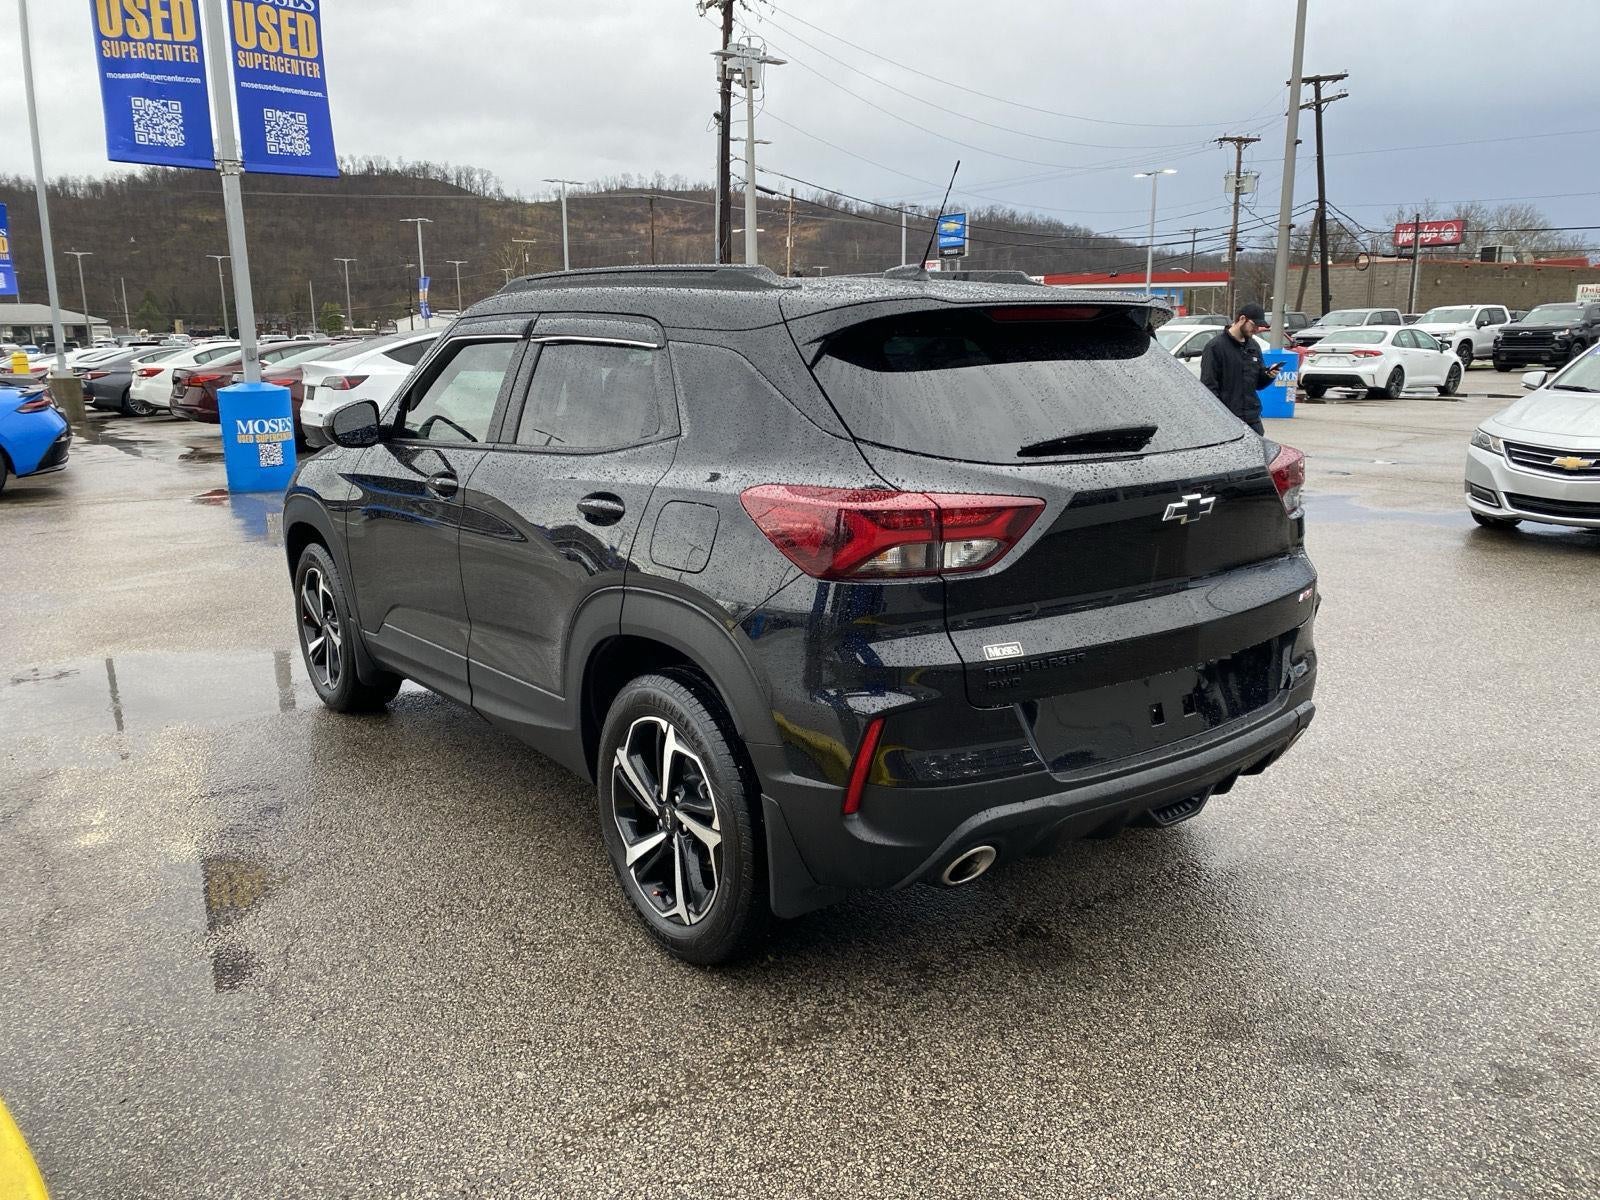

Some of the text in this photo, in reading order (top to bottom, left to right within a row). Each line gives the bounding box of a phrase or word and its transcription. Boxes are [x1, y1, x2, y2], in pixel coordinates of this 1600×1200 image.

[97, 0, 197, 41] USED
[232, 1, 319, 58] USED
[102, 40, 199, 63] SUPERCENTER
[237, 51, 321, 78] SUPERCENTER
[106, 72, 201, 84] mosesusedsupercenter.com
[240, 81, 323, 98] mosesusedsupercenter.com
[236, 417, 292, 434] MOSES
